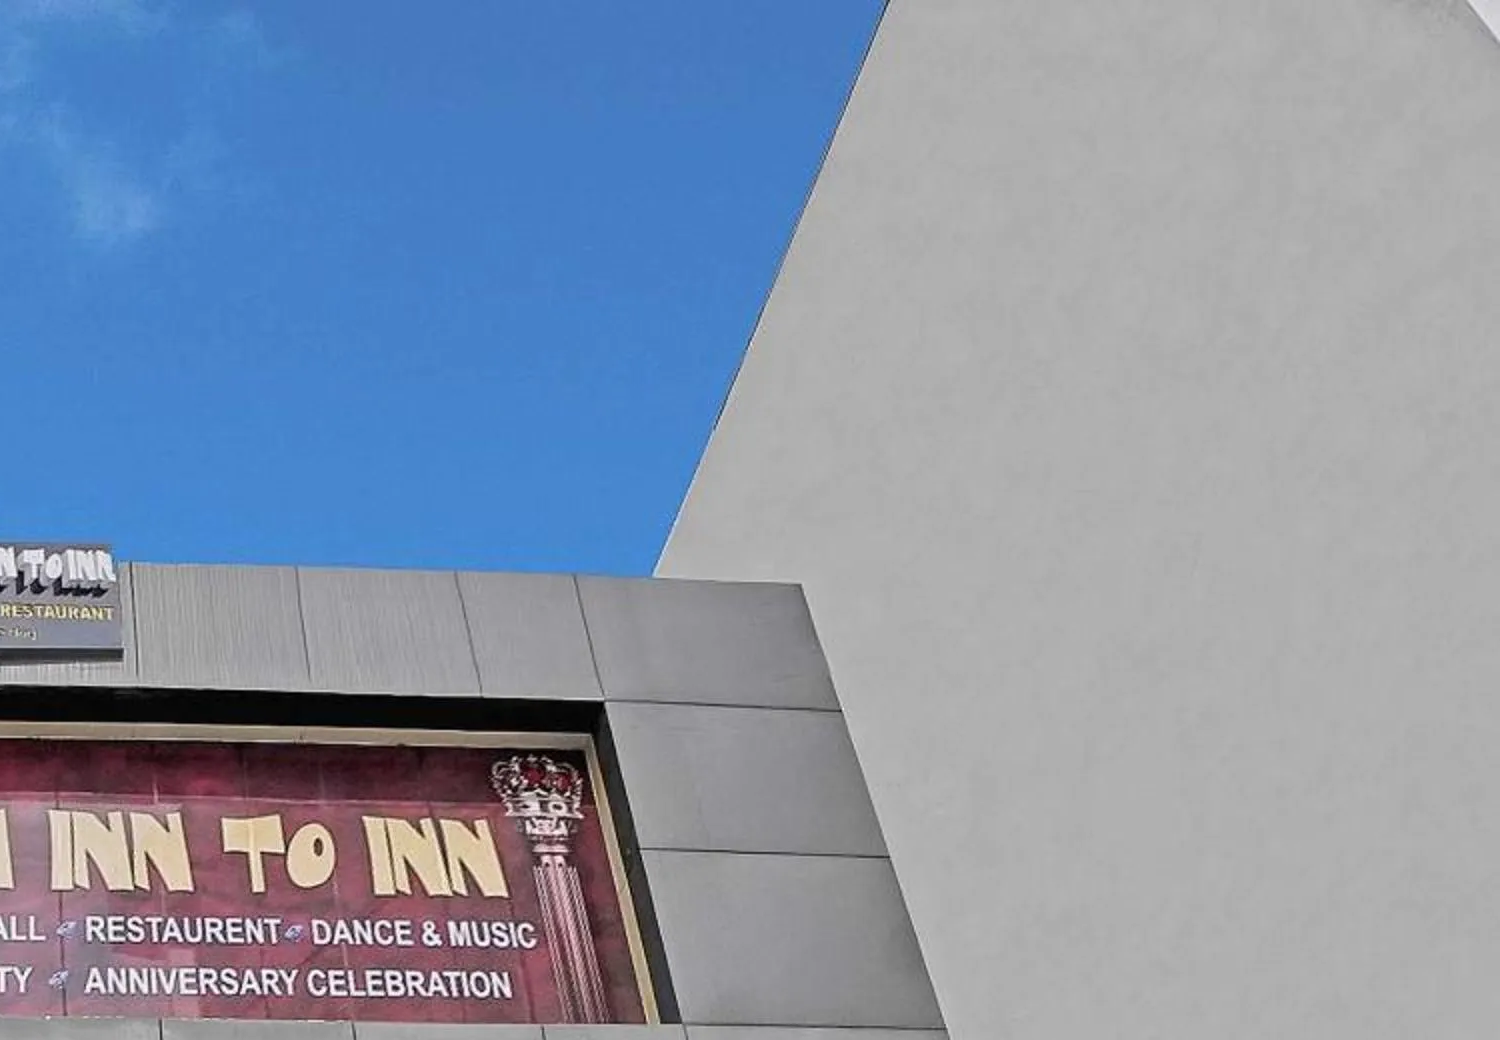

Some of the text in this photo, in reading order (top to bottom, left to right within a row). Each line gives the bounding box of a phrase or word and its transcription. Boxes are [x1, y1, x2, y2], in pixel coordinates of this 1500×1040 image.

[65, 550, 117, 583] INN
[0, 604, 115, 622] RESTAURANT
[45, 807, 195, 893] INN
[361, 815, 510, 898] INN
[85, 917, 282, 945] RESTAURENT
[311, 919, 414, 946] DANCE
[421, 921, 443, 948] &
[449, 921, 538, 949] MUSIC
[84, 968, 299, 997] ANNIVERSARY
[307, 971, 512, 999] CELEBRATION
